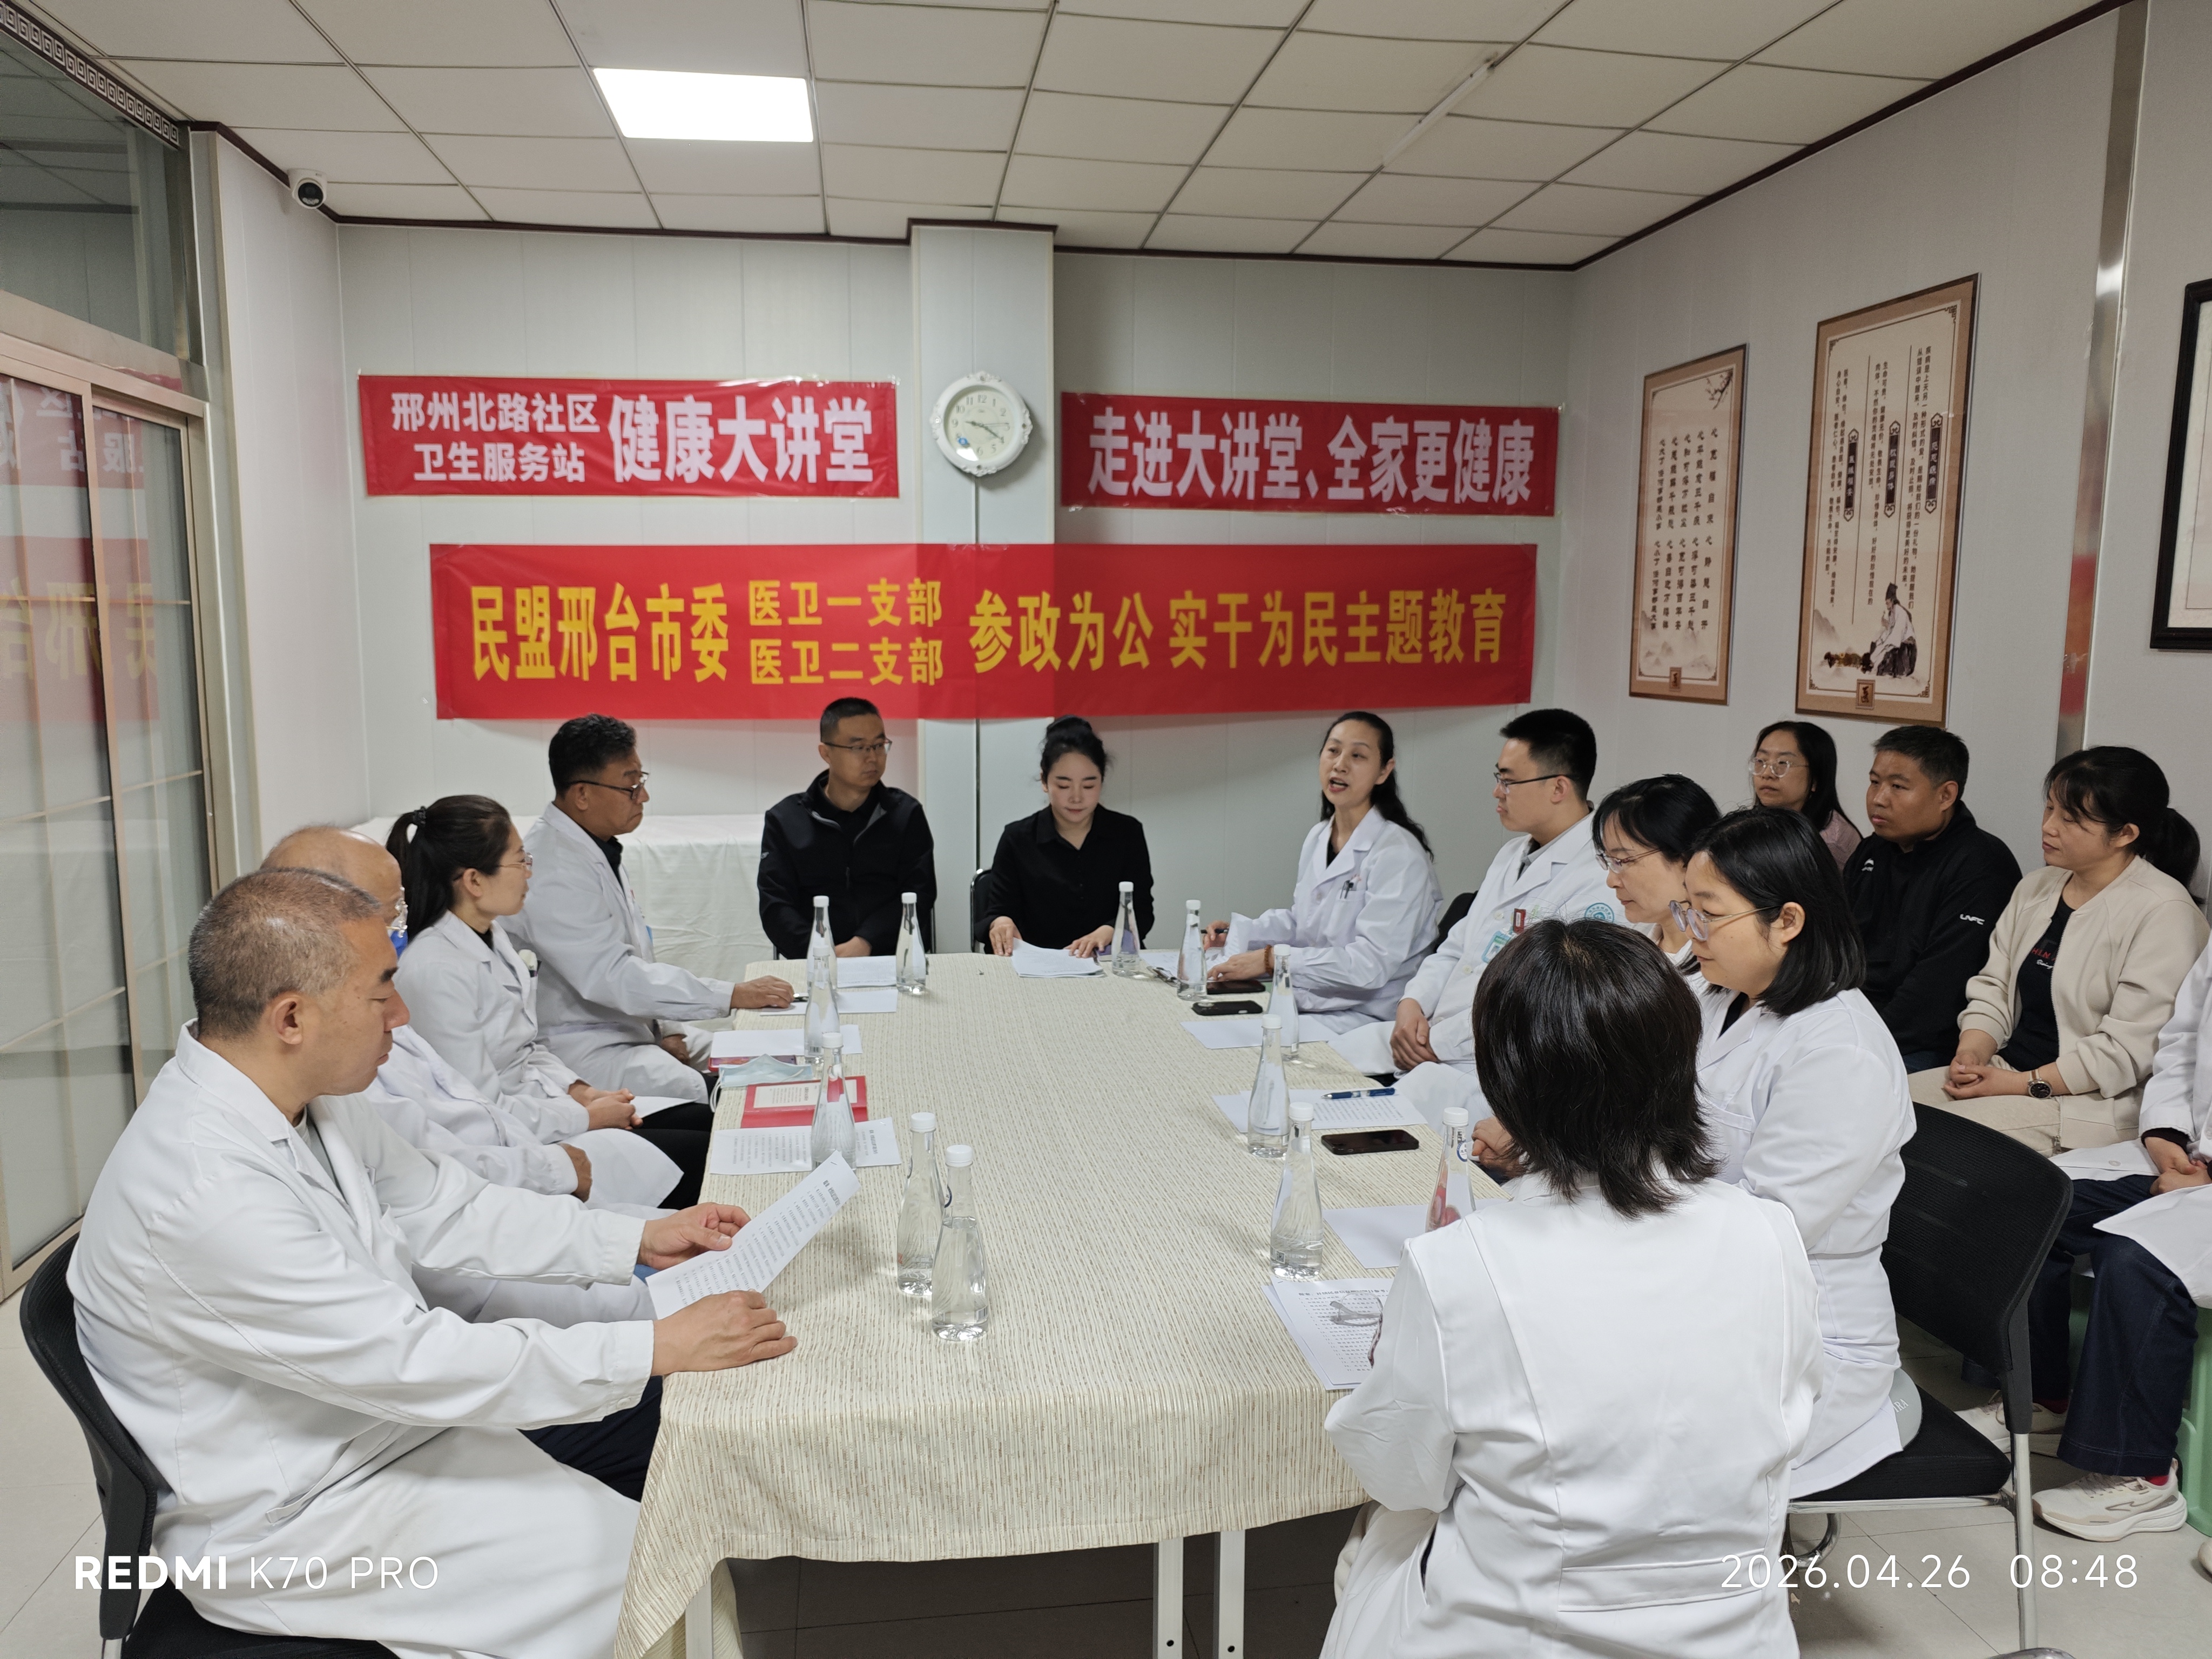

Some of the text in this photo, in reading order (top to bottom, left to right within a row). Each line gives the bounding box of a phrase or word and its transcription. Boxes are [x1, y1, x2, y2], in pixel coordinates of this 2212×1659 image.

[392, 392, 600, 433] 邢州北路社区
[608, 394, 873, 483] 健康大讲堂
[414, 441, 585, 482] 卫生服务站
[1087, 407, 1534, 505] 走进大讲堂、全家更健康
[471, 584, 728, 681] 民盟邢台市委
[750, 578, 941, 626] 医卫一支部
[970, 589, 1505, 672] 参政为公 实干为民主题教育
[751, 637, 942, 685] 医卫二支部
